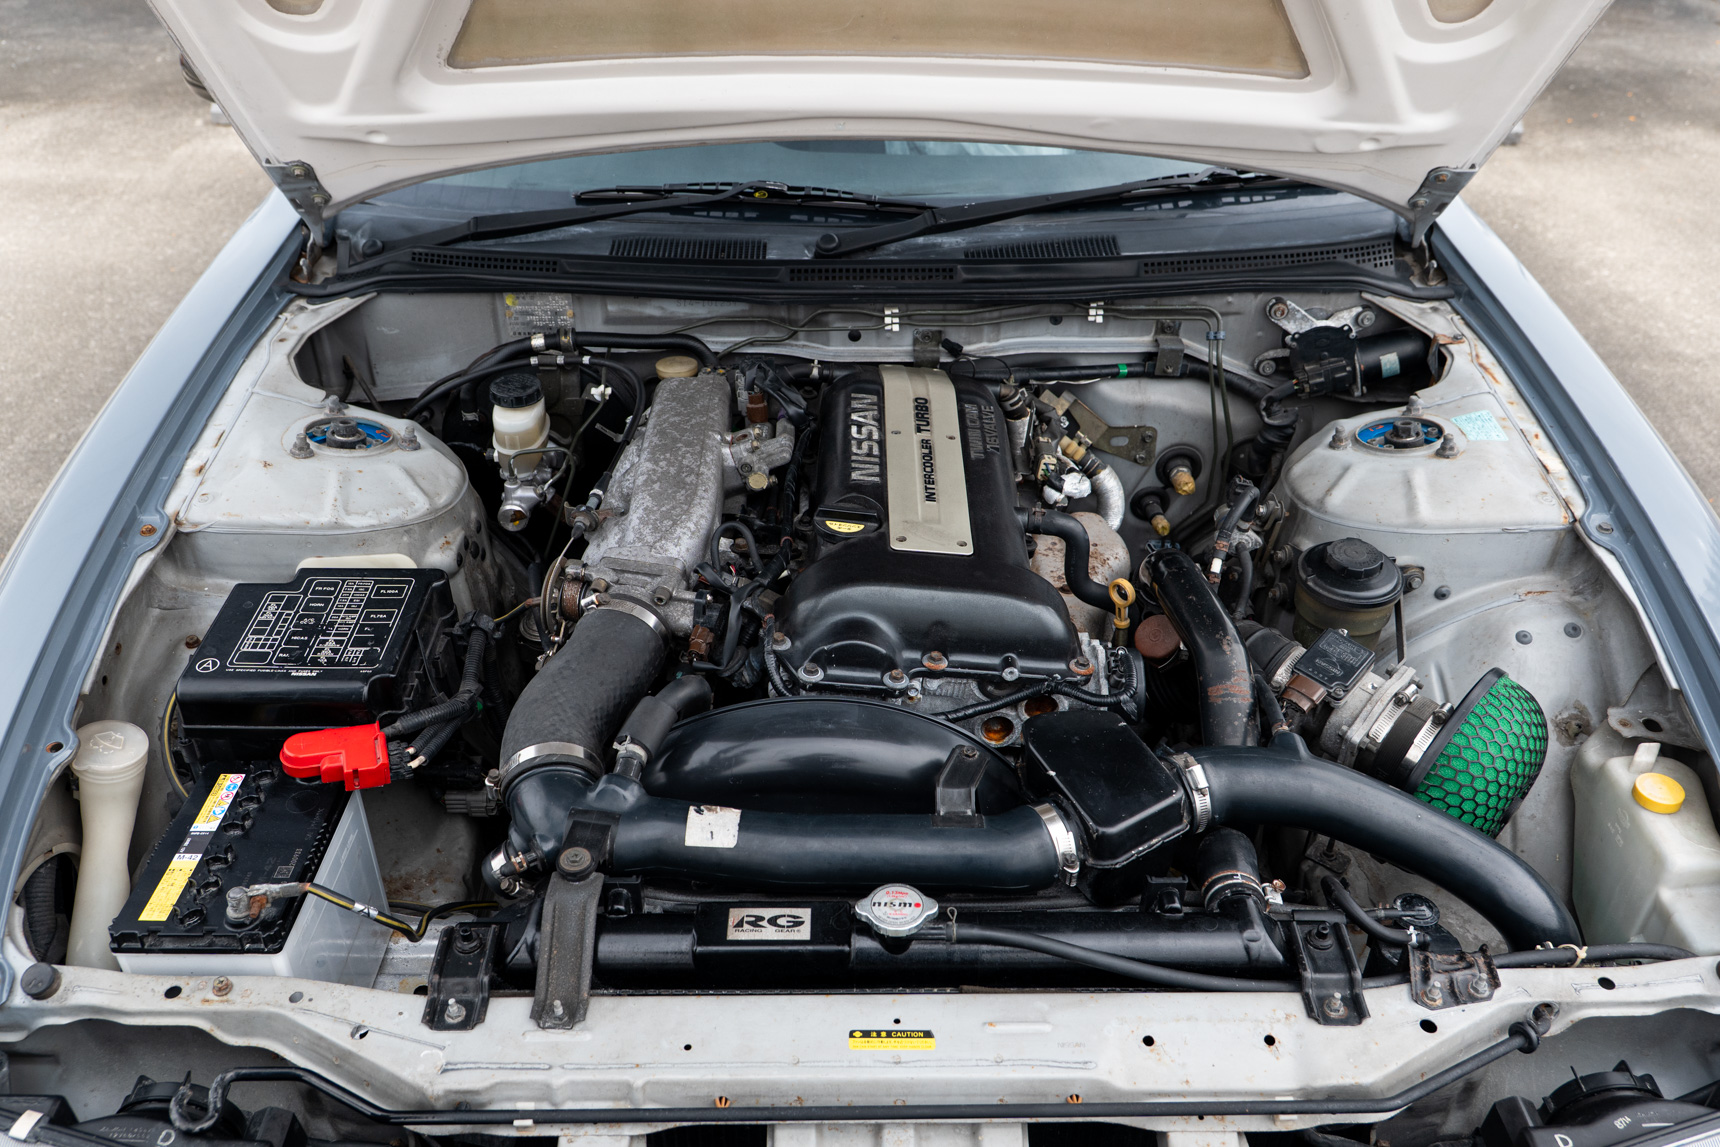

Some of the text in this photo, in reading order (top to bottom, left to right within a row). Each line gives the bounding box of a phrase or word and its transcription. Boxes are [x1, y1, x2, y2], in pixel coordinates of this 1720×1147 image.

[851, 393, 880, 484] NISSAN
[915, 397, 937, 502] INTERCOOLER TURBO
[733, 914, 806, 929] RG
[156, 1129, 175, 1146] D
